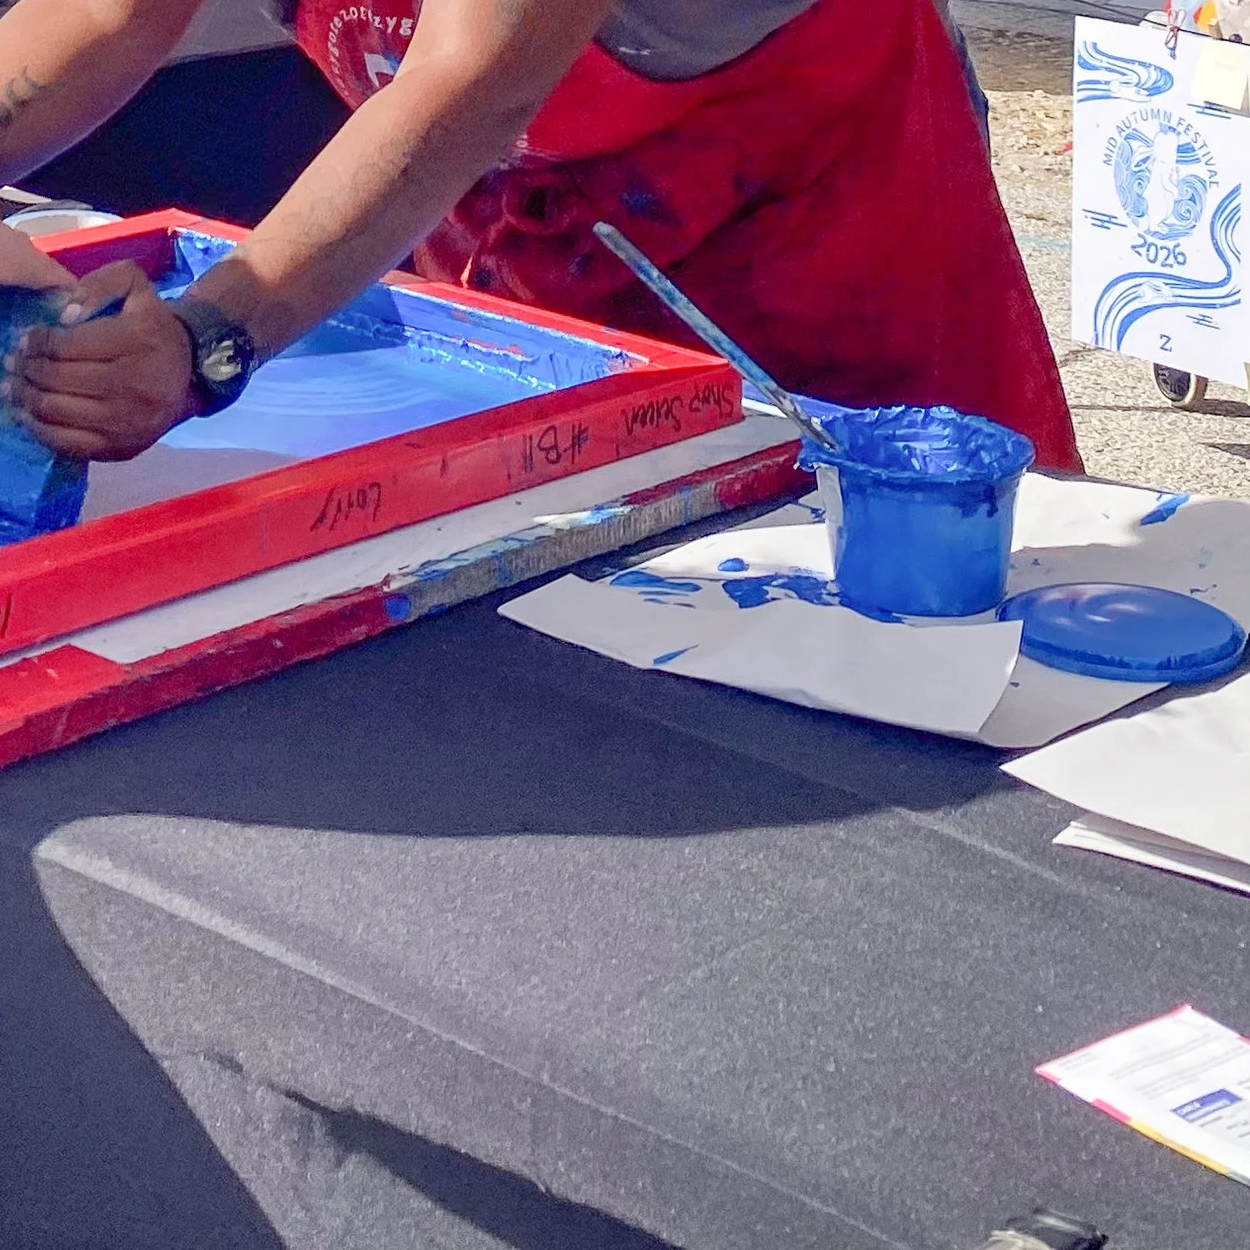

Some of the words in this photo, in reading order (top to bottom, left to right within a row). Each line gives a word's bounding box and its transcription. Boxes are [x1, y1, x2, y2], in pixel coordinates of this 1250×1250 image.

[1102, 137, 1118, 166] MID
[1115, 108, 1172, 139] AUTUMN
[1177, 117, 1219, 189] FESTIVAL
[1131, 232, 1187, 268] 2026
[1158, 335, 1173, 353] Z
